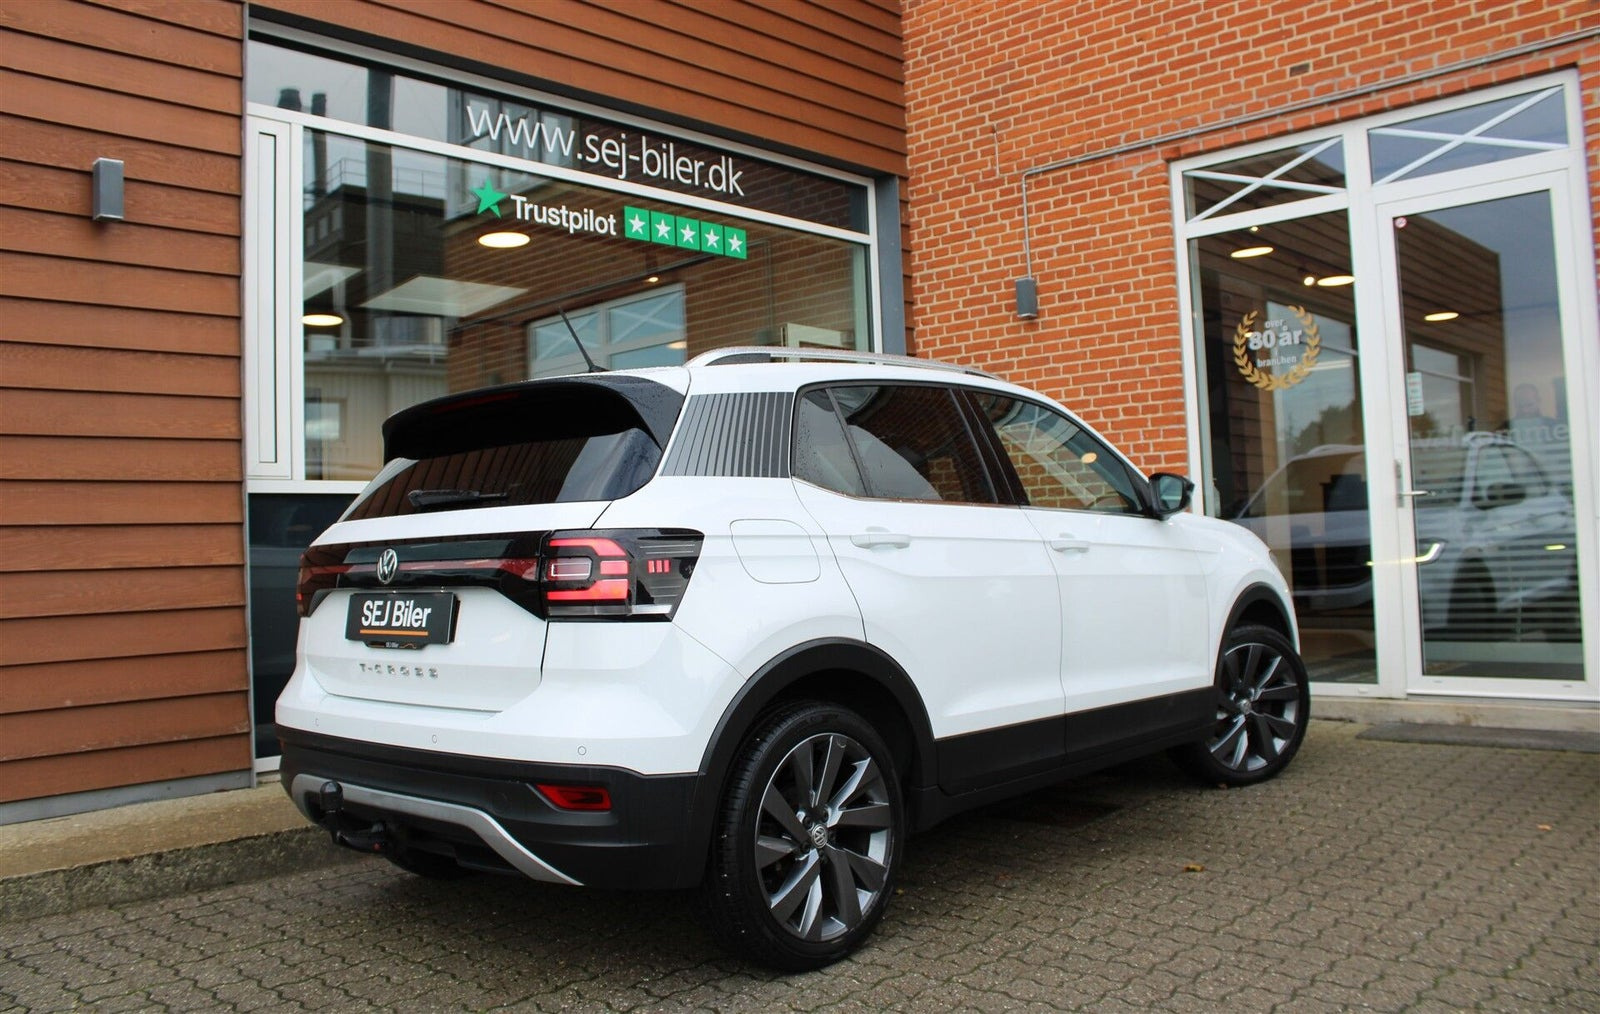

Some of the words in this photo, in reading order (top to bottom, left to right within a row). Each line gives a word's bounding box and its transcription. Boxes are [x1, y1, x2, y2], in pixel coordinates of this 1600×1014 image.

[467, 105, 745, 197] www.sej-biler.dk
[510, 194, 617, 236] Trustpilot
[1265, 320, 1283, 329] over
[1249, 330, 1275, 350] 80
[1279, 326, 1302, 346] år
[361, 600, 391, 627] SEJ
[391, 600, 432, 628] Biler
[359, 663, 438, 678] T-CROSS
